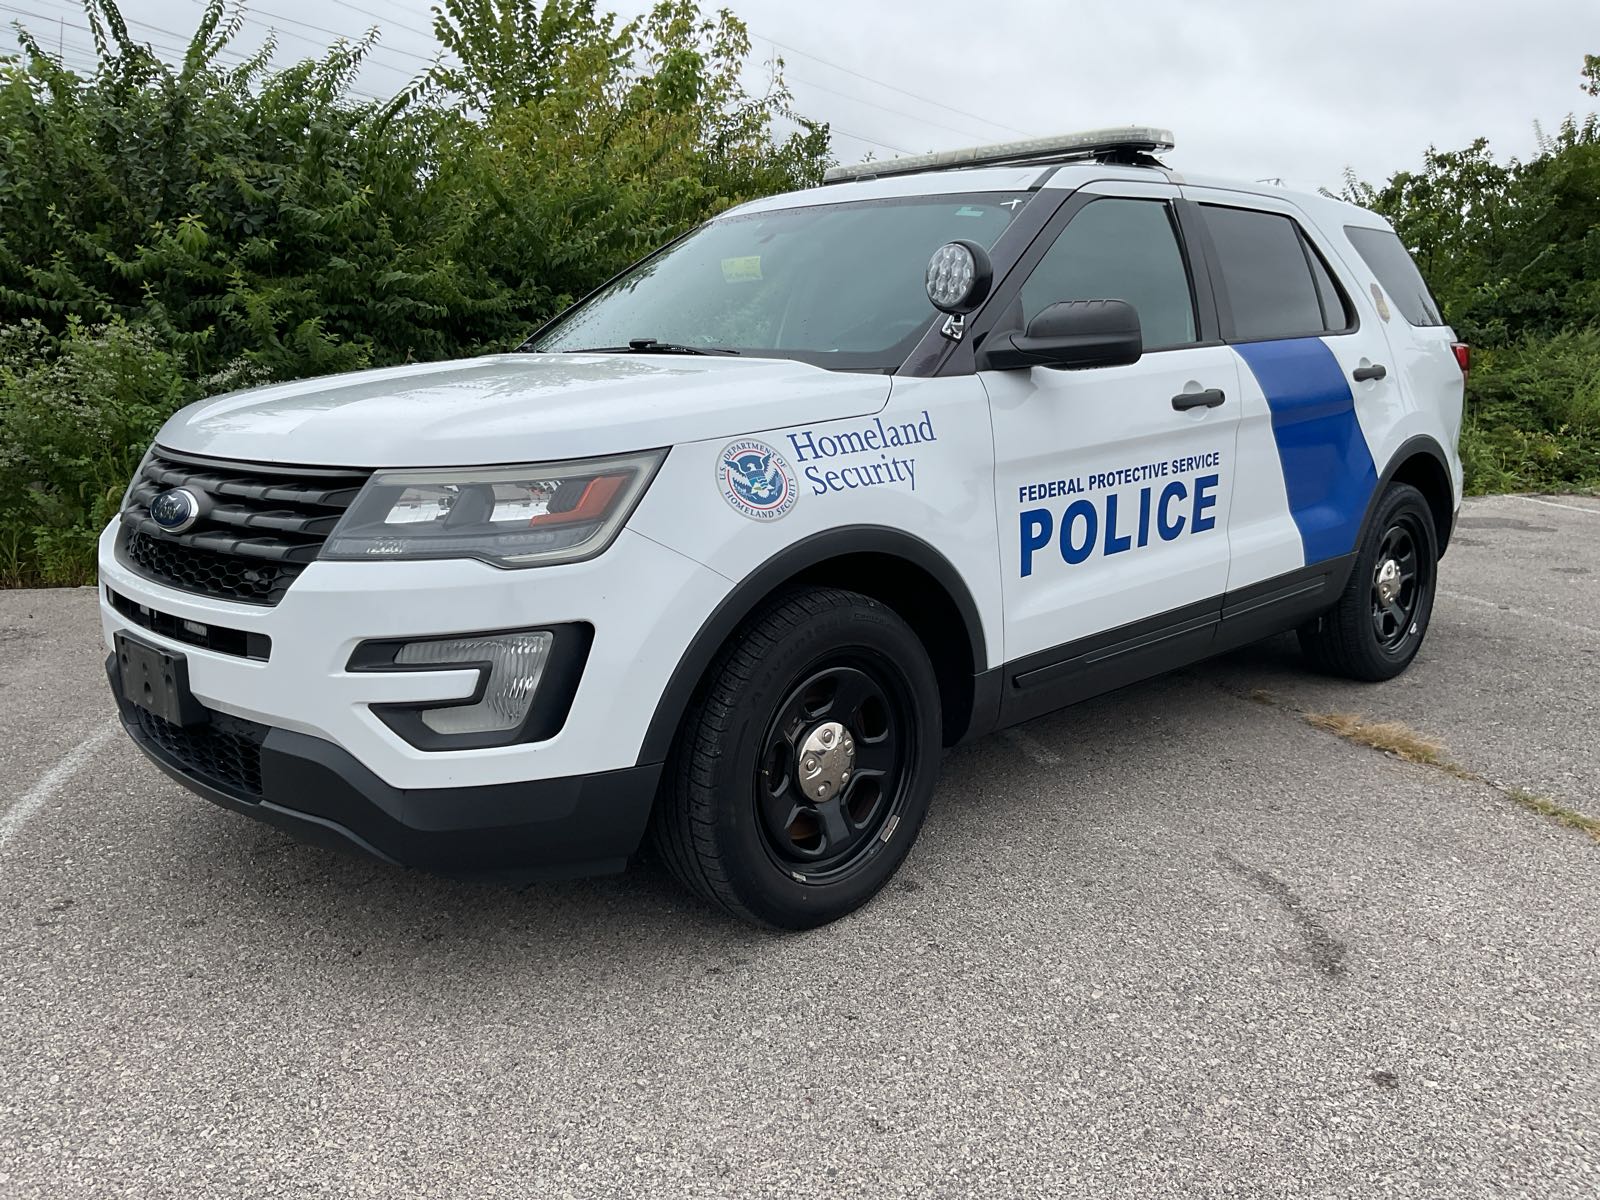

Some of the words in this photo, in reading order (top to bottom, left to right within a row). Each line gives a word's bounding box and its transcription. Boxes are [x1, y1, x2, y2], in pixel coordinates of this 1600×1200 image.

[724, 442, 776, 460] DEPARTMENT
[777, 457, 787, 469] OF
[787, 411, 937, 462] Homeland
[725, 491, 774, 518] HOMELAND
[776, 477, 796, 515] SECURITY
[805, 454, 915, 496] Security
[1019, 477, 1084, 503] FEDERAL
[1088, 461, 1168, 491] PROTECTIVE
[1172, 452, 1220, 474] SERVICE
[1019, 473, 1219, 578] POLICE
